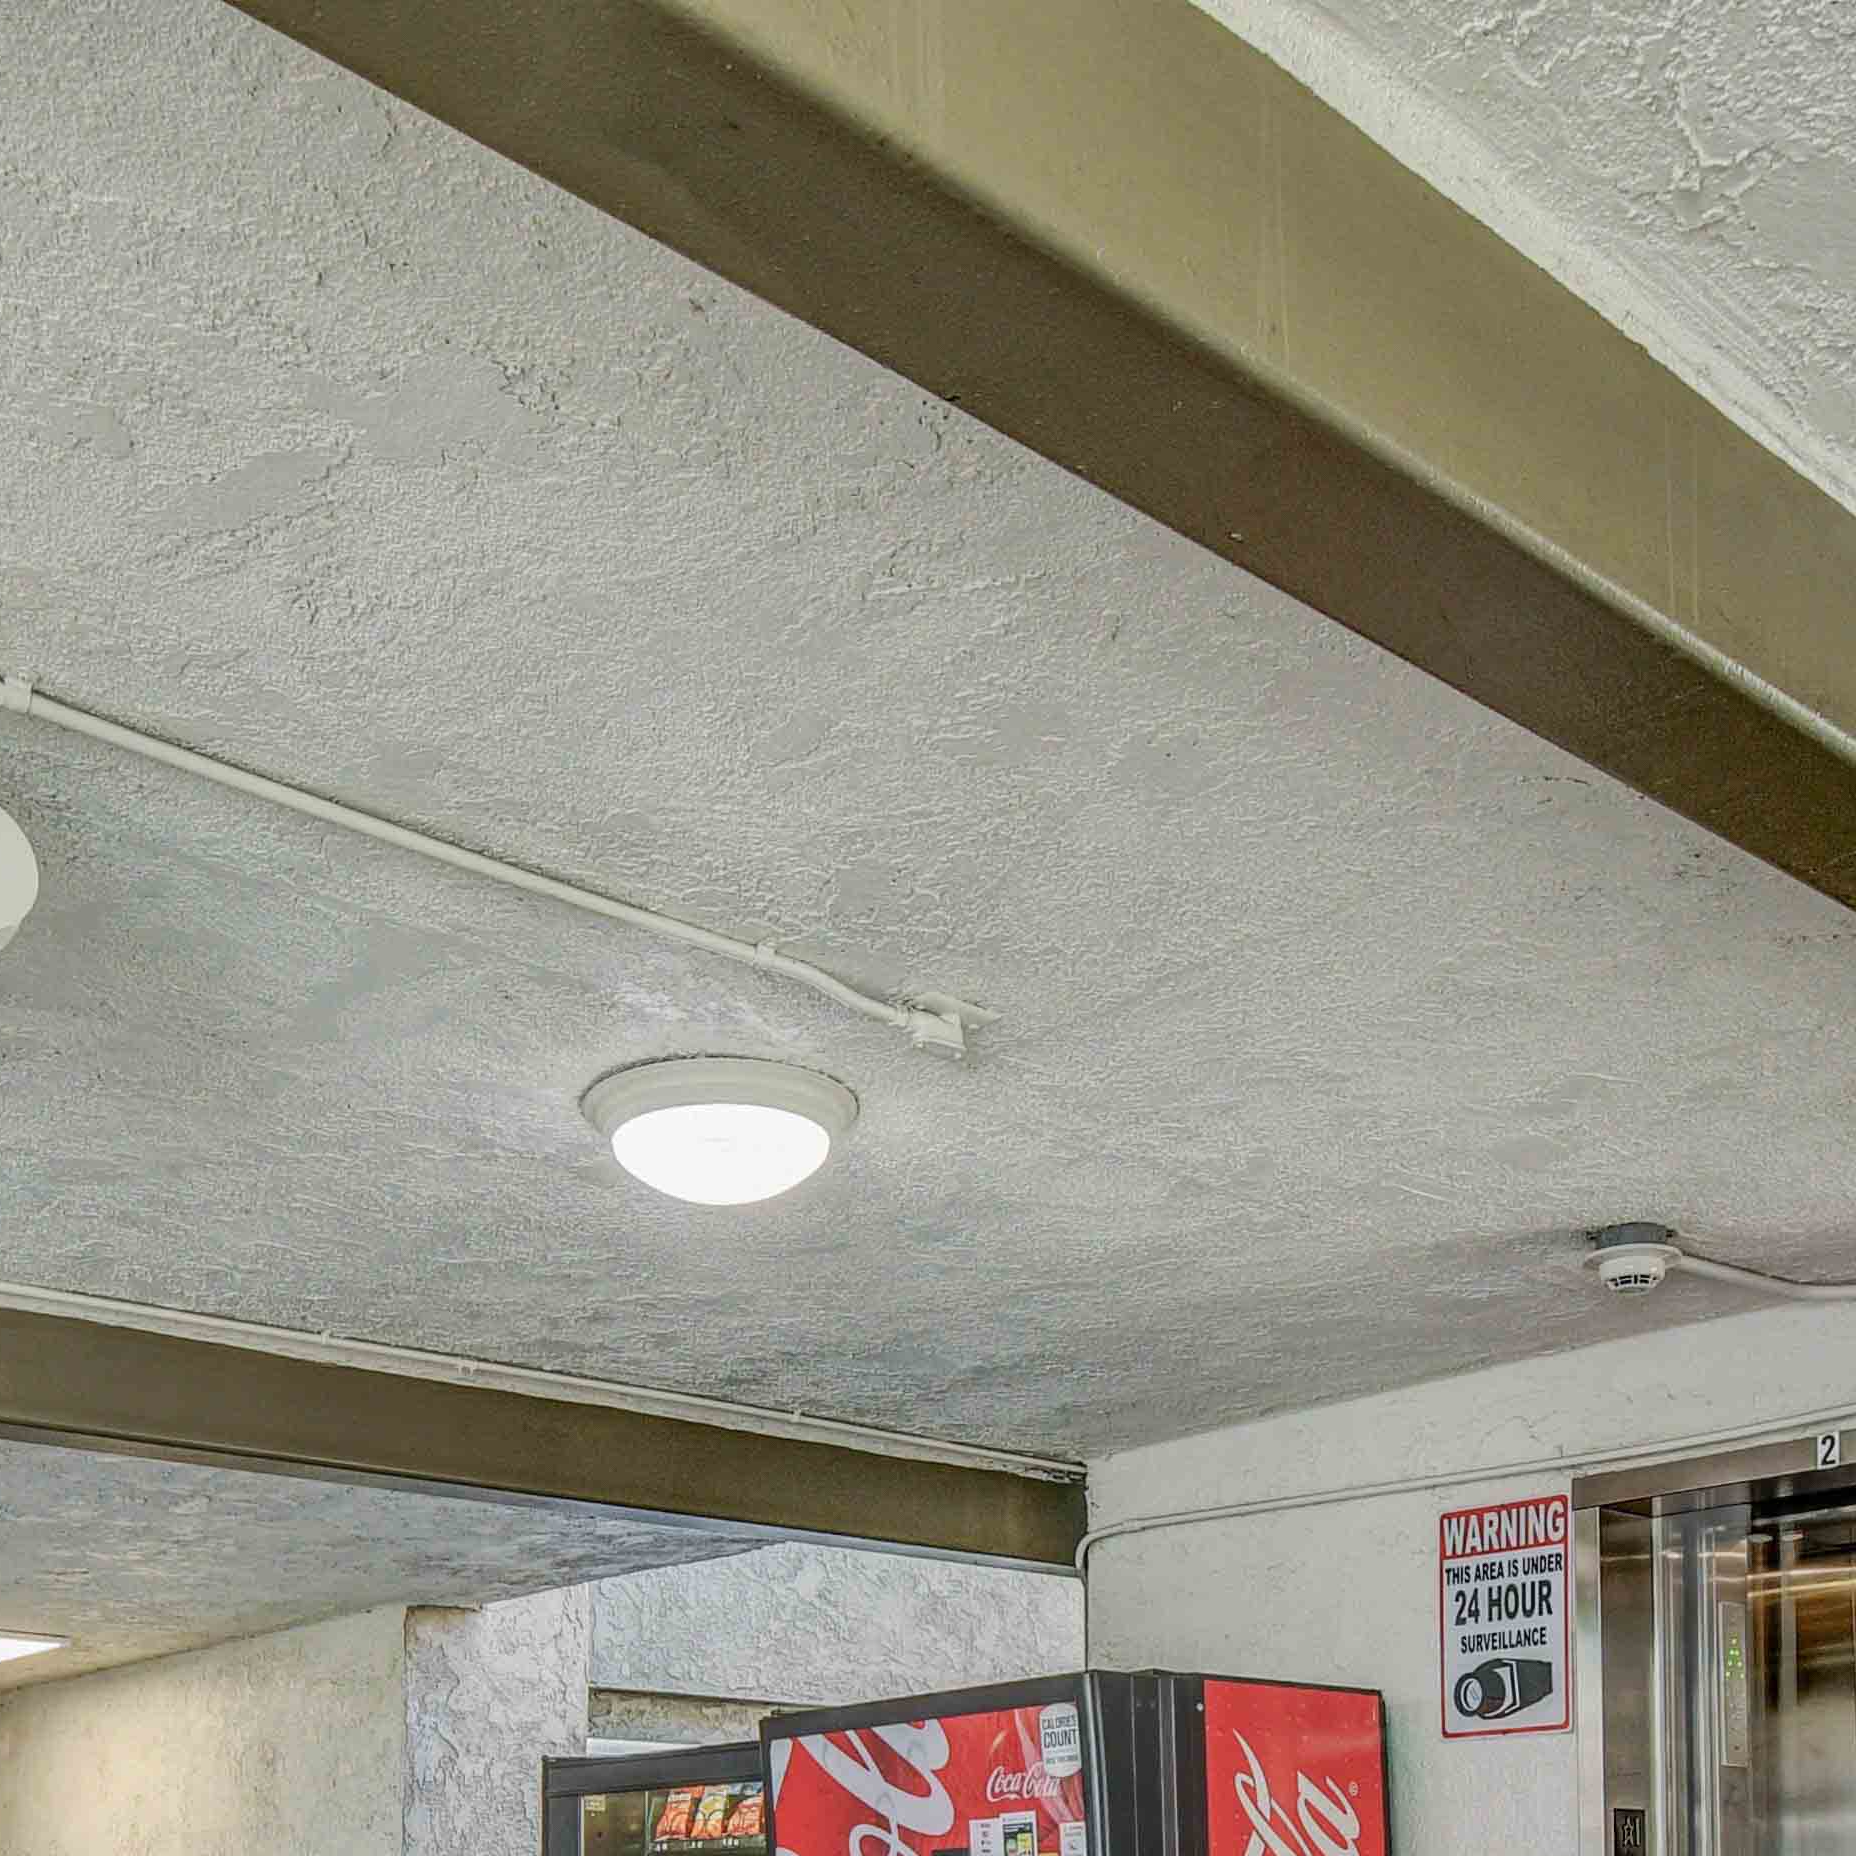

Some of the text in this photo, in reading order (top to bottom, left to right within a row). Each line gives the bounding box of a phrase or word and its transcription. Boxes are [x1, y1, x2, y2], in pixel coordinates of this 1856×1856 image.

[1821, 1435, 1836, 1466] 2
[1442, 1500, 1565, 1558] WARNING
[1445, 1552, 1563, 1587] THIS AREA IS UNDER
[1454, 1579, 1553, 1627] 24 HOUR
[1460, 1626, 1547, 1655] SURVEILLANCE
[1043, 1729, 1077, 1748] COUNT
